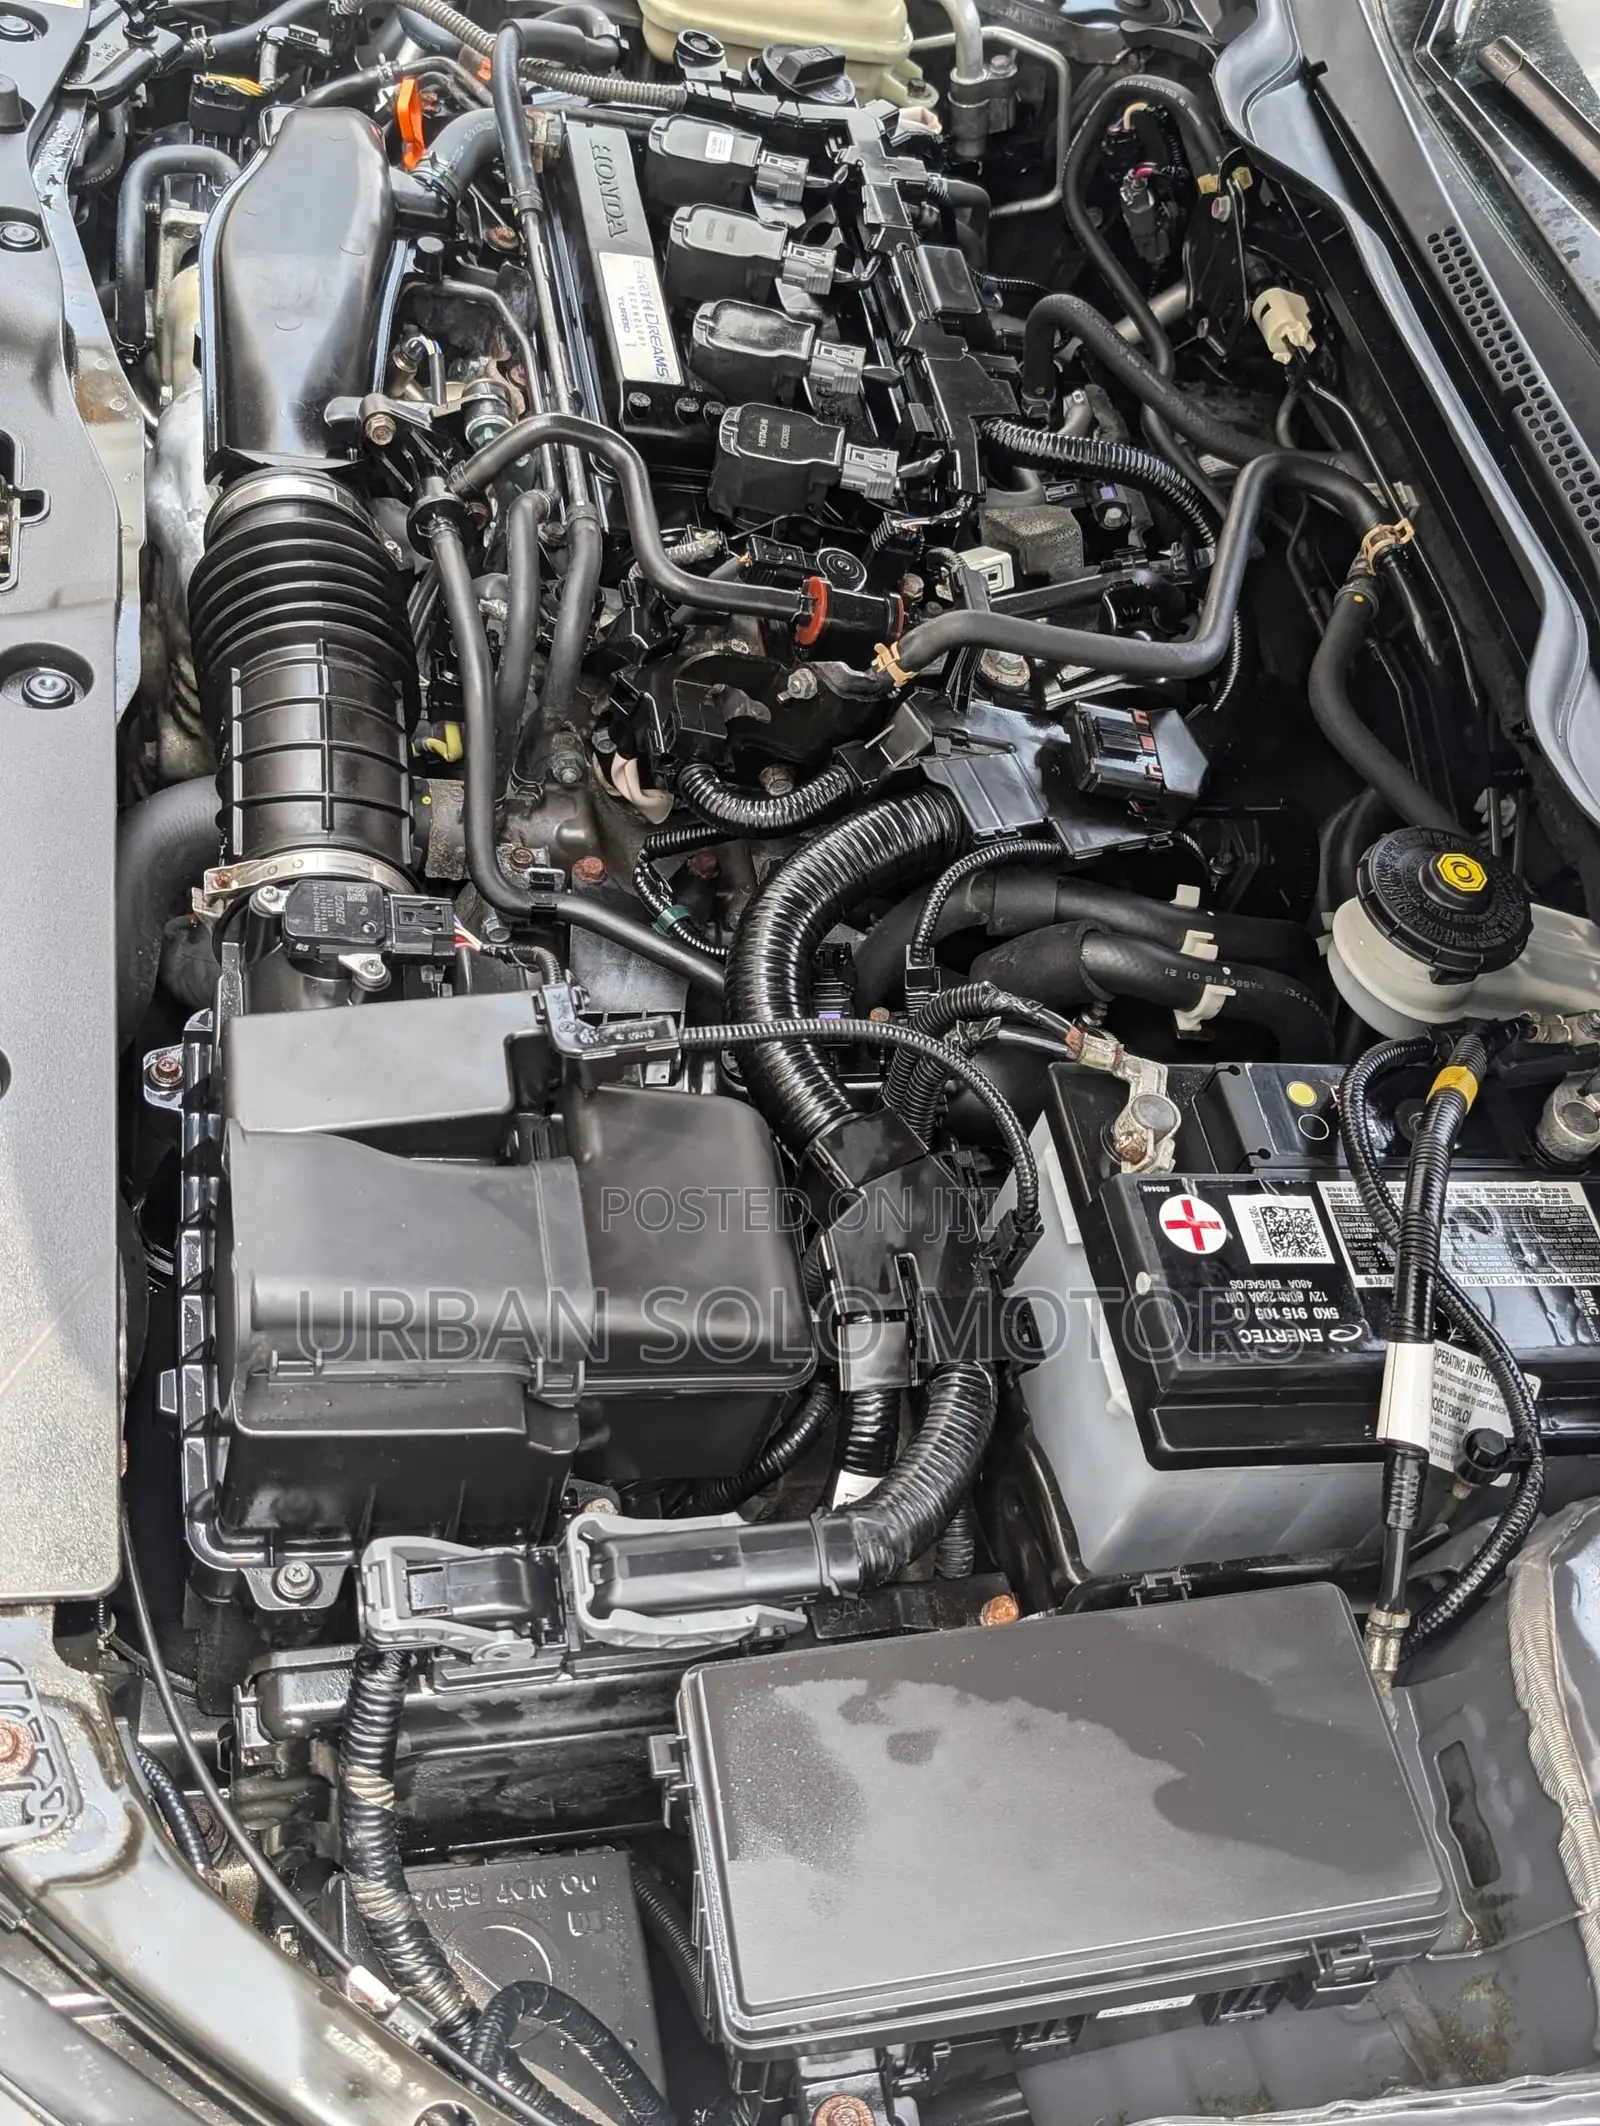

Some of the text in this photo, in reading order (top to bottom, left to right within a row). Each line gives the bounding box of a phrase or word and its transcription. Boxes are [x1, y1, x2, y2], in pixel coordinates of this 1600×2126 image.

[588, 138, 629, 238] HONDA
[616, 294, 632, 335] TURBO
[632, 259, 670, 379] EARTH DREAMS
[757, 418, 769, 448] HITACHI
[334, 894, 346, 925] DENSO
[1287, 1280, 1312, 1289] 480A
[1224, 1292, 1245, 1304] DIN
[1248, 1291, 1276, 1302] 280A
[1308, 1291, 1328, 1302] 12V
[1580, 1289, 1600, 1316] EMC
[1234, 1308, 1246, 1320] D
[1254, 1308, 1280, 1320] 105
[1282, 1307, 1308, 1320] 915
[1239, 1328, 1324, 1343] ENERTEC
[1585, 1316, 1600, 1343] MEXICO
[1431, 1397, 1444, 1415] ODE
[410, 1872, 599, 1910] DO NOT REMO
